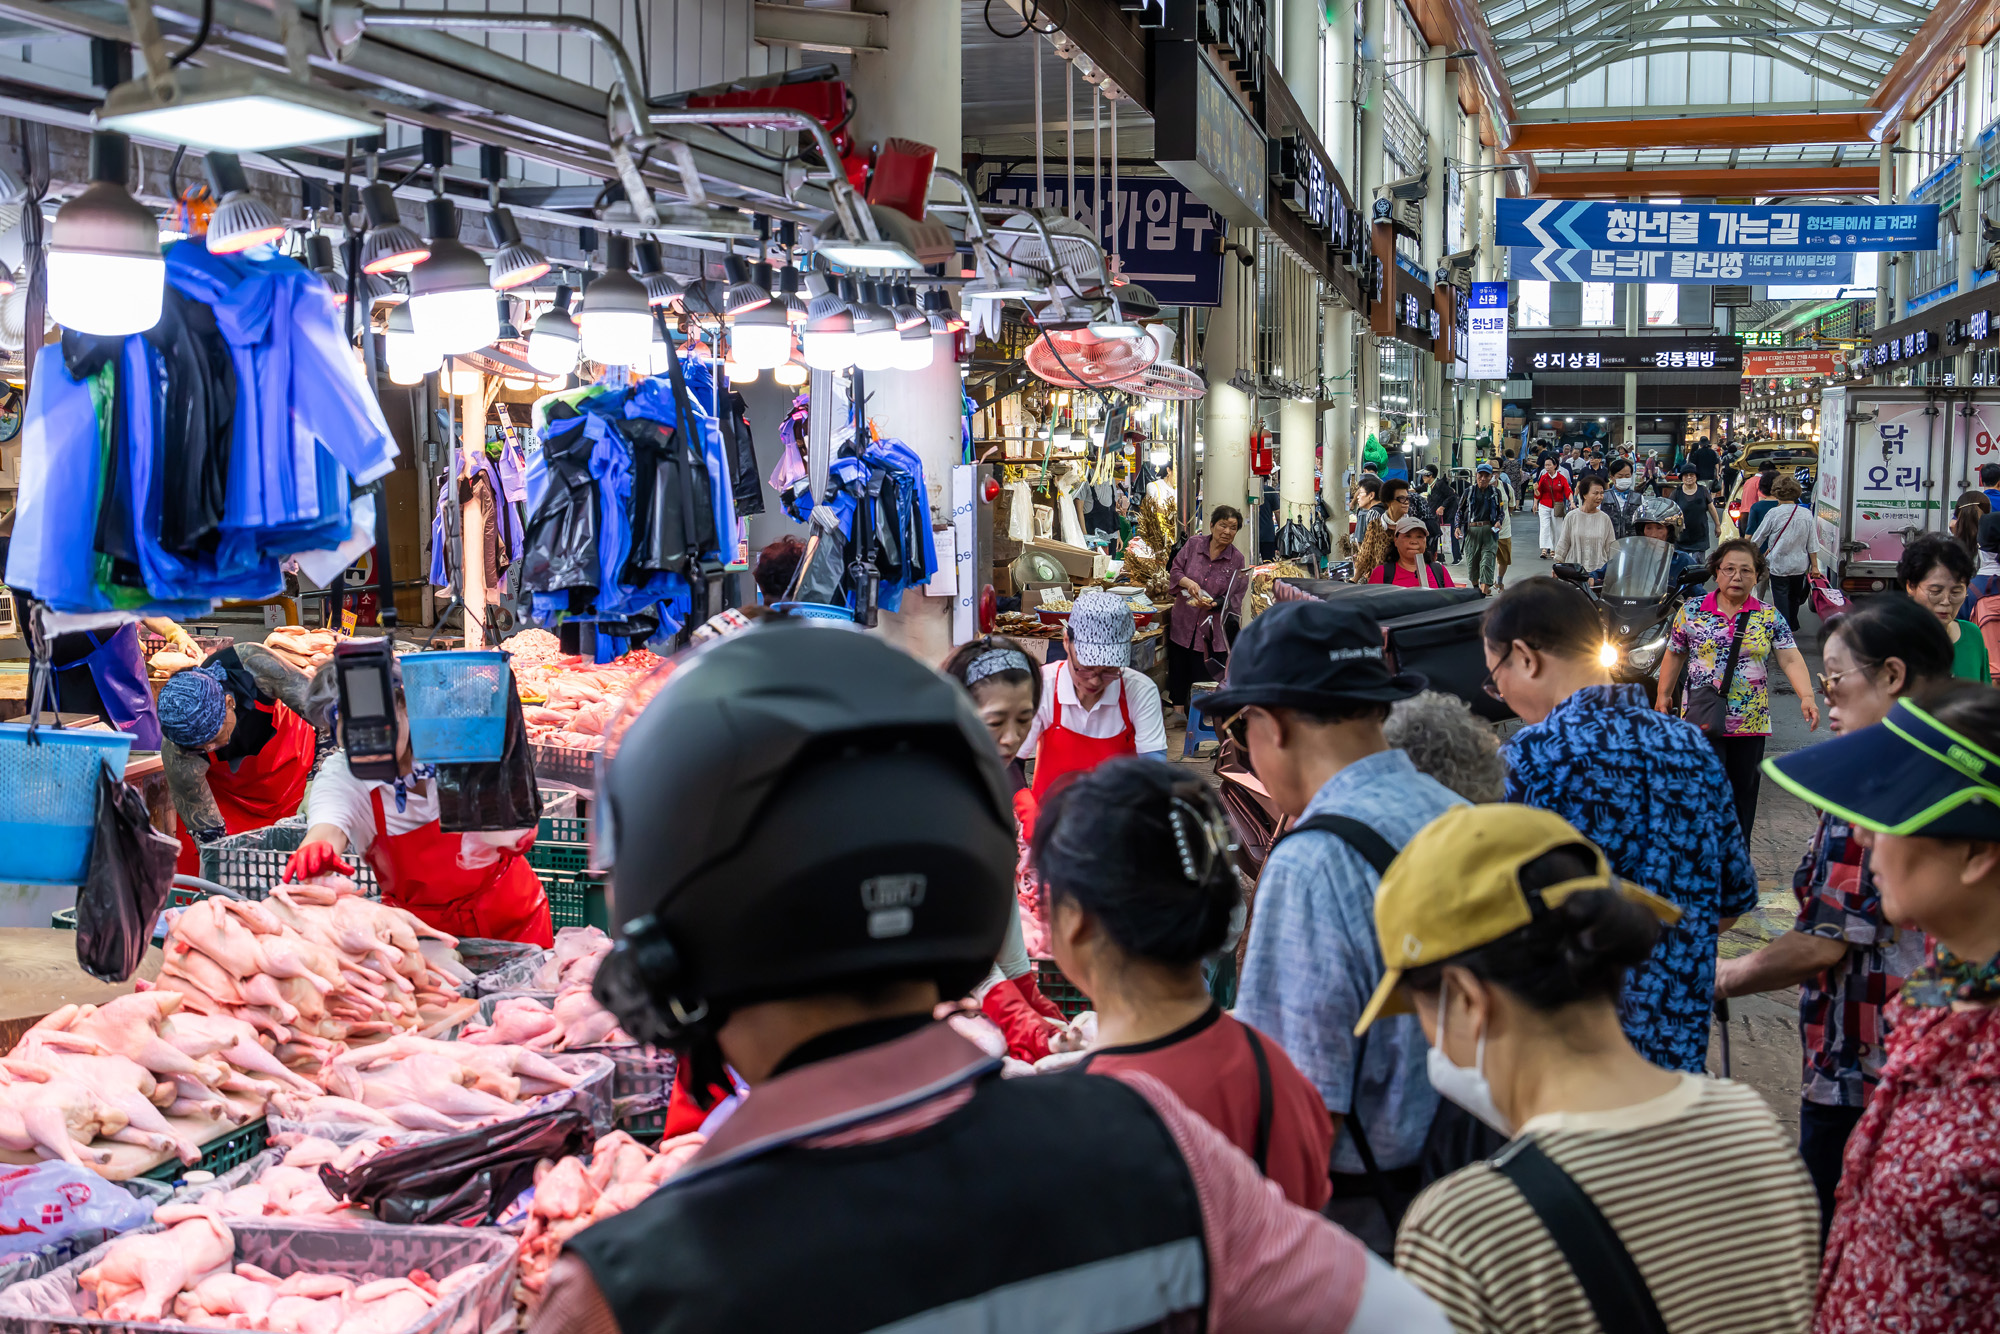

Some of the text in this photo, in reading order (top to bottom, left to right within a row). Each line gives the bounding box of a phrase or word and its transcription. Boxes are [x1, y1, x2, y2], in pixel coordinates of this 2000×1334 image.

[1607, 209, 1800, 245] 청년몰 가는길
[1806, 215, 1918, 230] 청년몰에서 즐겨라!
[1479, 294, 1498, 305] 신관
[1472, 318, 1504, 330] 청년몰
[1532, 352, 1600, 369] 성지상회
[1655, 351, 1715, 368] 경동웰빙
[1880, 424, 1909, 455] 닭
[1863, 465, 1922, 493] 오리
